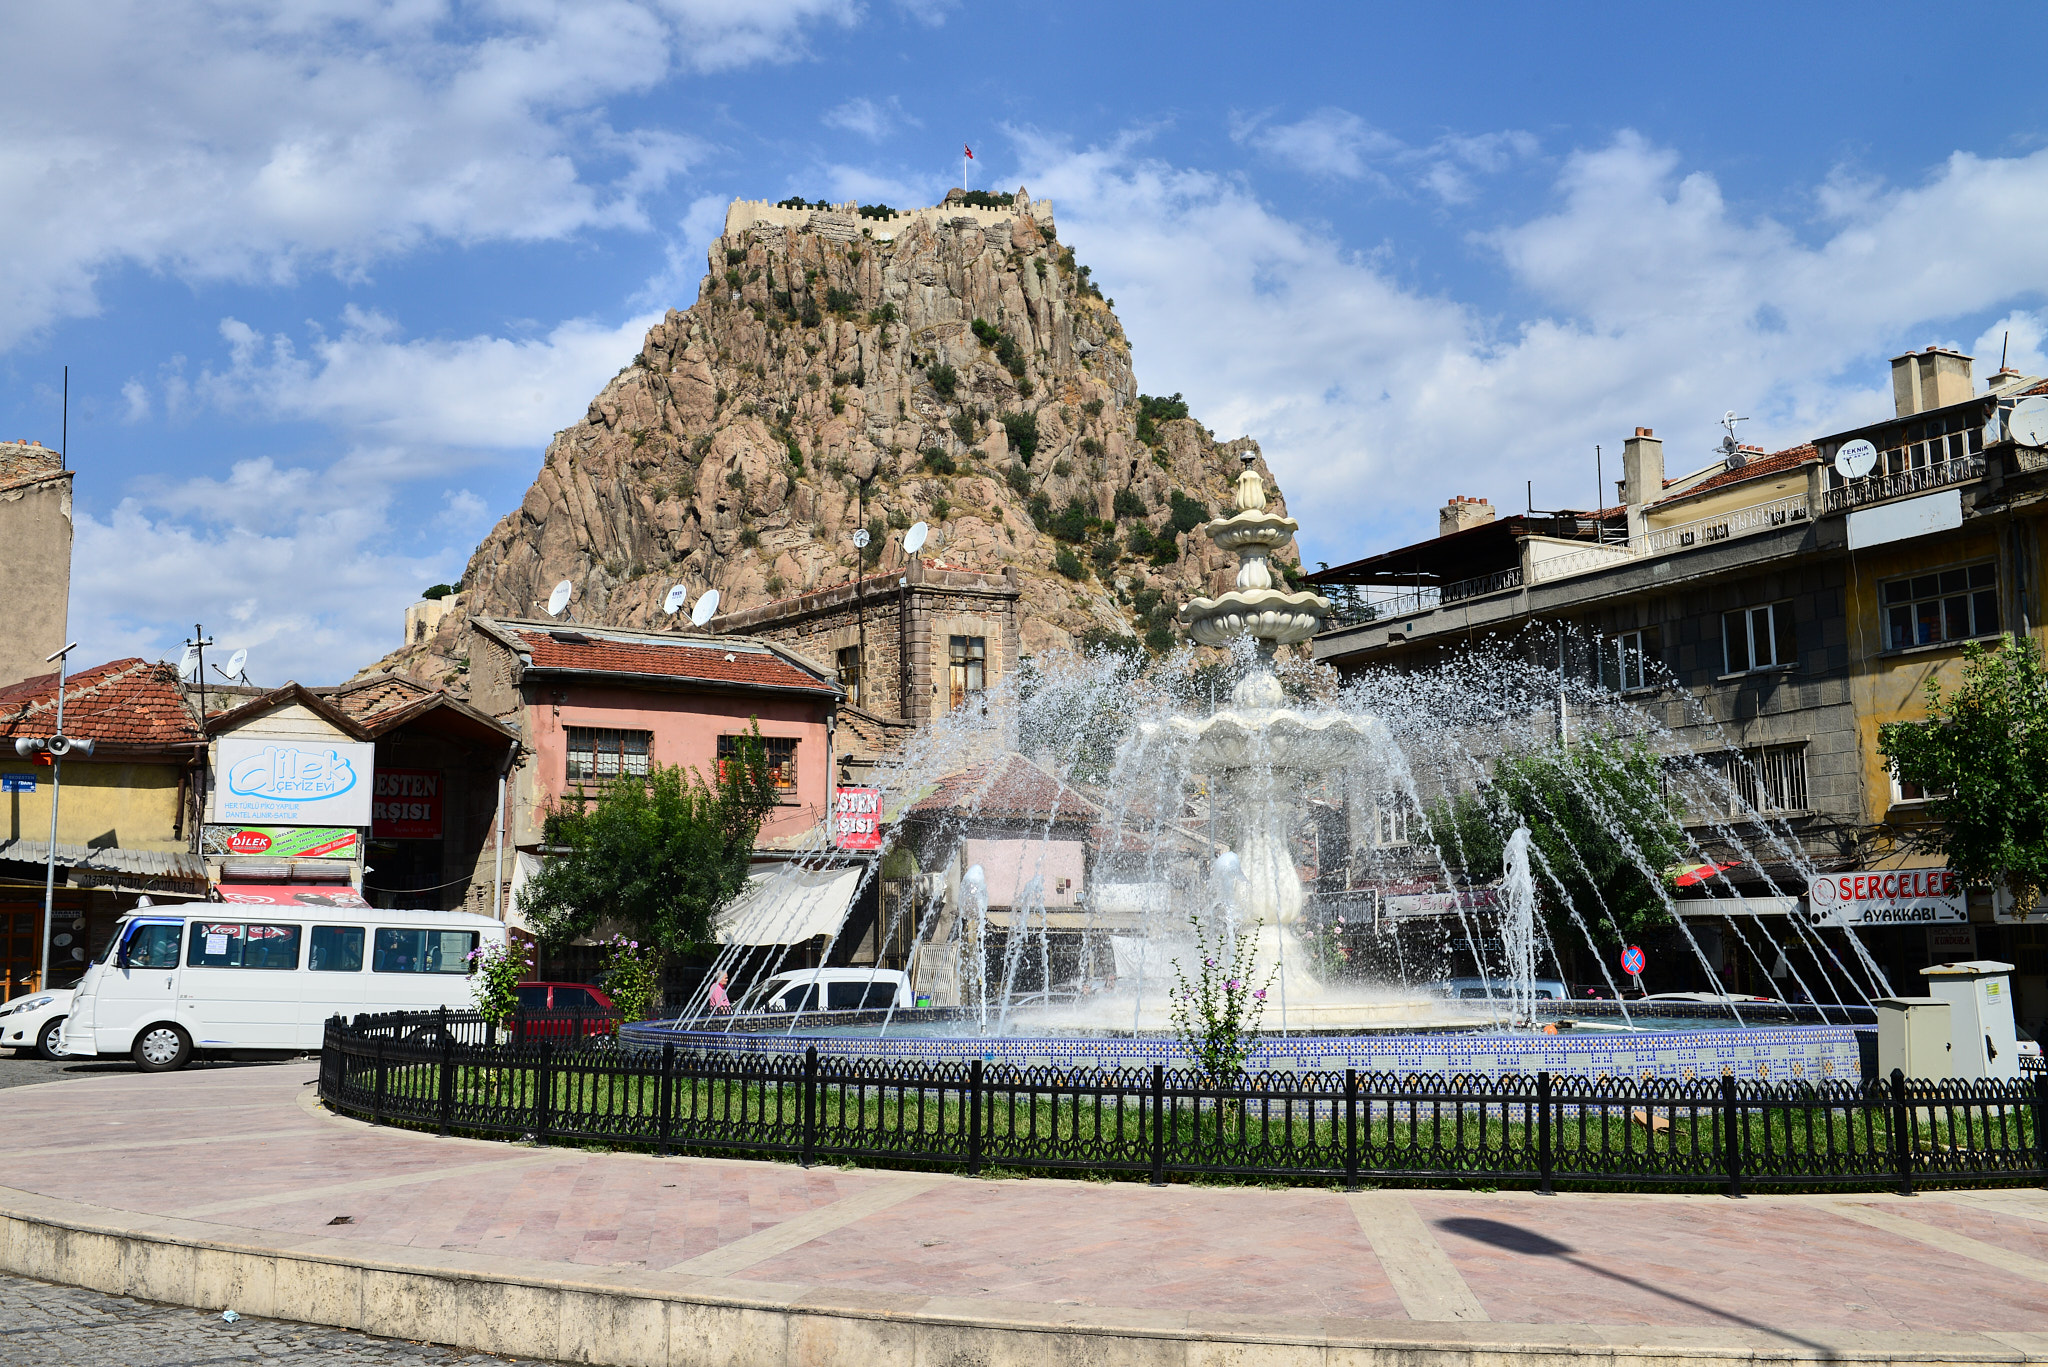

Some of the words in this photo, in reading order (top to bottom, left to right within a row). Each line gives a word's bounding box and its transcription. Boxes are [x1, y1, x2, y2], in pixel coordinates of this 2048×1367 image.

[276, 781, 313, 793] ÇEYİZ
[316, 781, 335, 792] EVİ
[374, 773, 438, 797] ESTEN
[239, 802, 259, 810] TÜRLÜ
[276, 803, 299, 811] YAPILIR
[225, 811, 250, 819] DANTEL
[837, 818, 875, 836] ŞISI
[232, 836, 269, 846] DİLEK
[82, 874, 113, 888] MERVE
[1864, 907, 1937, 922] AYAKKABI
